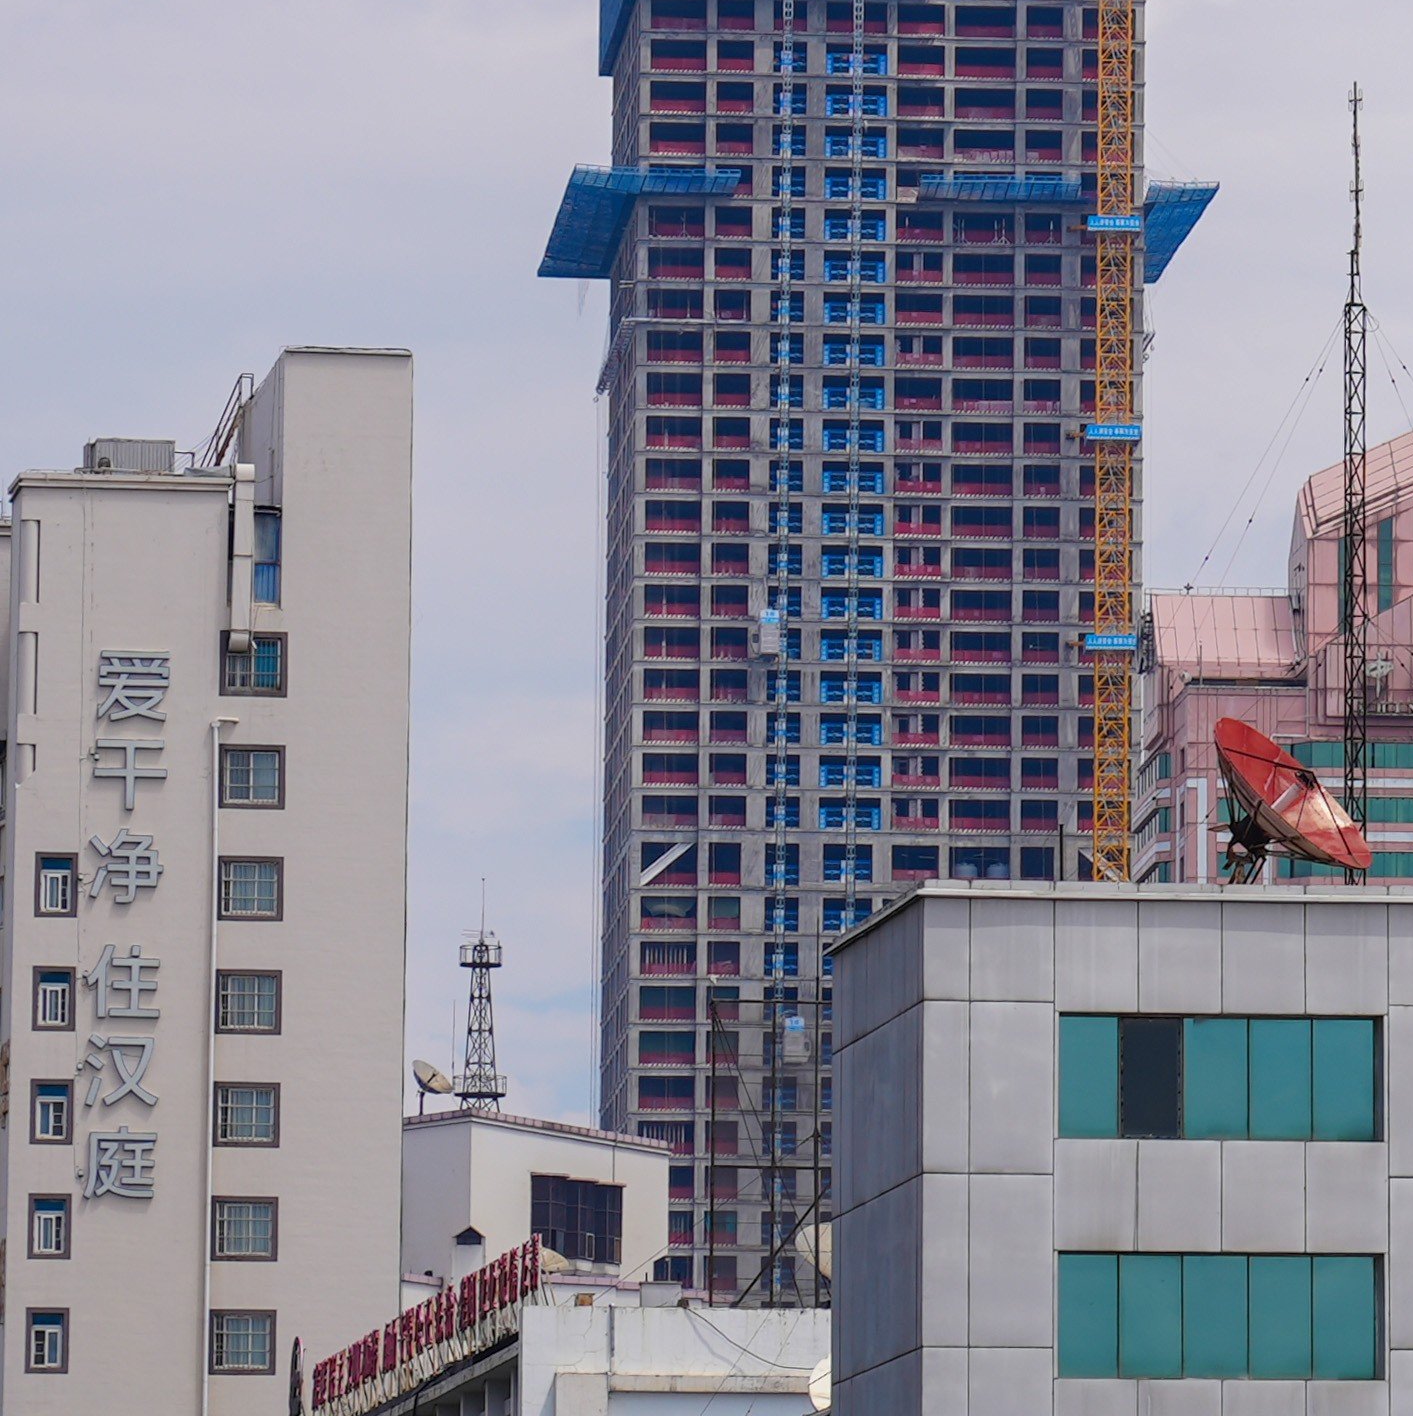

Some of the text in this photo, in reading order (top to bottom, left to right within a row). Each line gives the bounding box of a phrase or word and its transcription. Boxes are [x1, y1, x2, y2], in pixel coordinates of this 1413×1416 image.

[82, 649, 171, 1201] 爱干净 住汉庭
